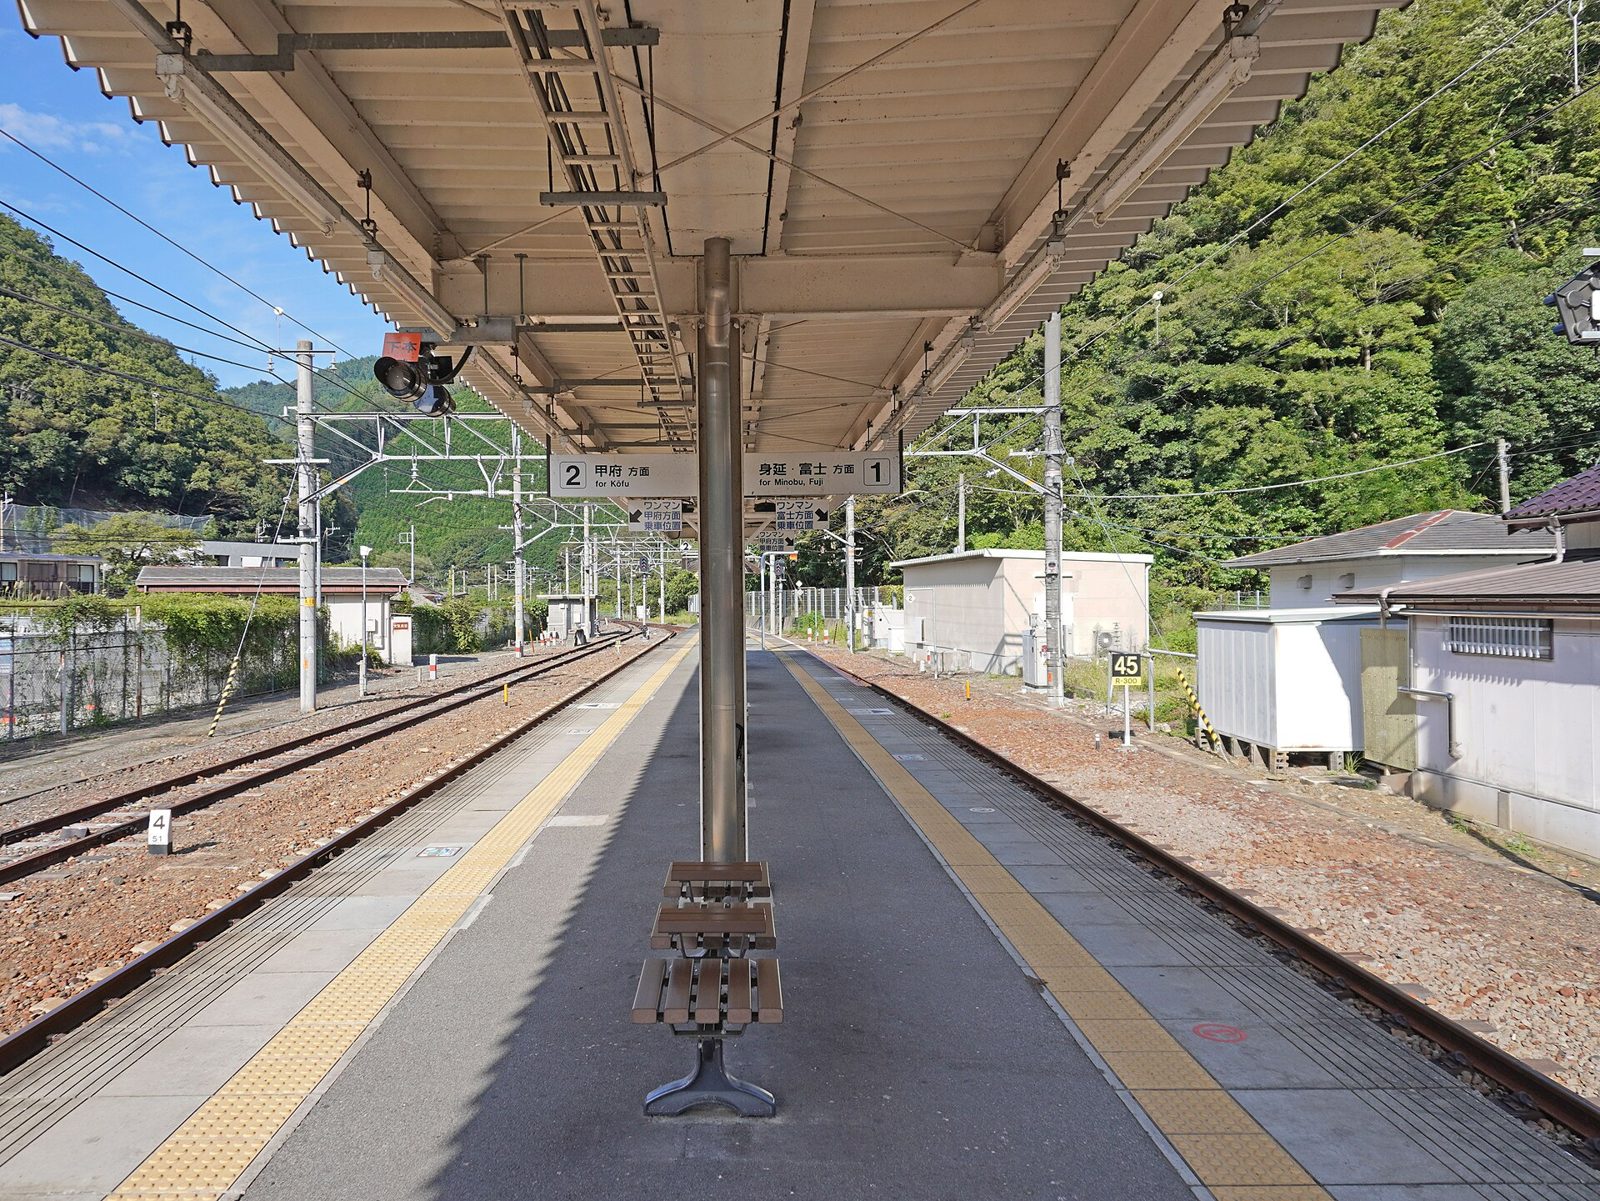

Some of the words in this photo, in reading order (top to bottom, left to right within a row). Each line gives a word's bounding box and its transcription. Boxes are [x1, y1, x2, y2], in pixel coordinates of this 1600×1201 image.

[594, 464, 623, 477] 甲府
[628, 466, 650, 477] 方面
[832, 464, 855, 475] 方面
[870, 462, 881, 482] 1
[565, 464, 581, 486] 2
[595, 480, 607, 488] for
[759, 478, 771, 486] for
[774, 478, 806, 487] Minobu,
[808, 478, 824, 486] Fuji
[643, 501, 680, 510] ワンマン
[776, 501, 813, 510] ワンマン
[643, 511, 681, 520] 甲府方面
[776, 510, 814, 520] 富士方面
[643, 521, 681, 530] 乗車位置
[776, 520, 814, 530] 乗車位置
[682, 542, 689, 551] 2
[908, 593, 913, 602] 2
[1114, 655, 1139, 675] 45
[152, 815, 166, 829] 4
